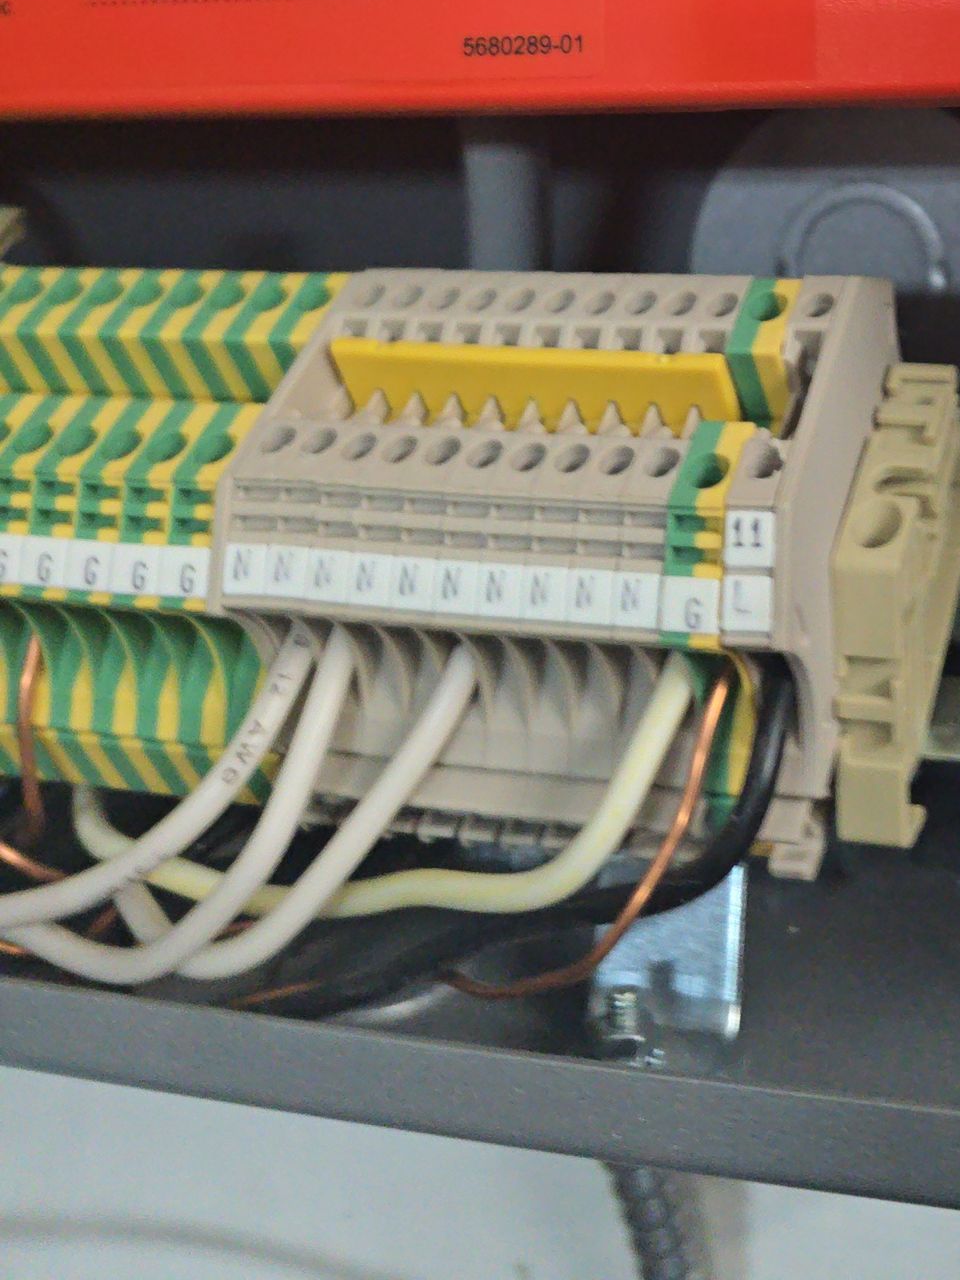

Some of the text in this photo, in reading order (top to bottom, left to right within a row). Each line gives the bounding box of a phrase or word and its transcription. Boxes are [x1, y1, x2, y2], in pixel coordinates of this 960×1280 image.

[464, 34, 583, 57] 5680289-01
[731, 517, 763, 548] 11
[37, 550, 54, 583] G
[84, 556, 101, 587] G
[132, 560, 149, 591] G
[180, 563, 197, 594] G
[233, 548, 641, 612] N N N N N N N N N N
[684, 597, 704, 629] G
[732, 579, 753, 615] L
